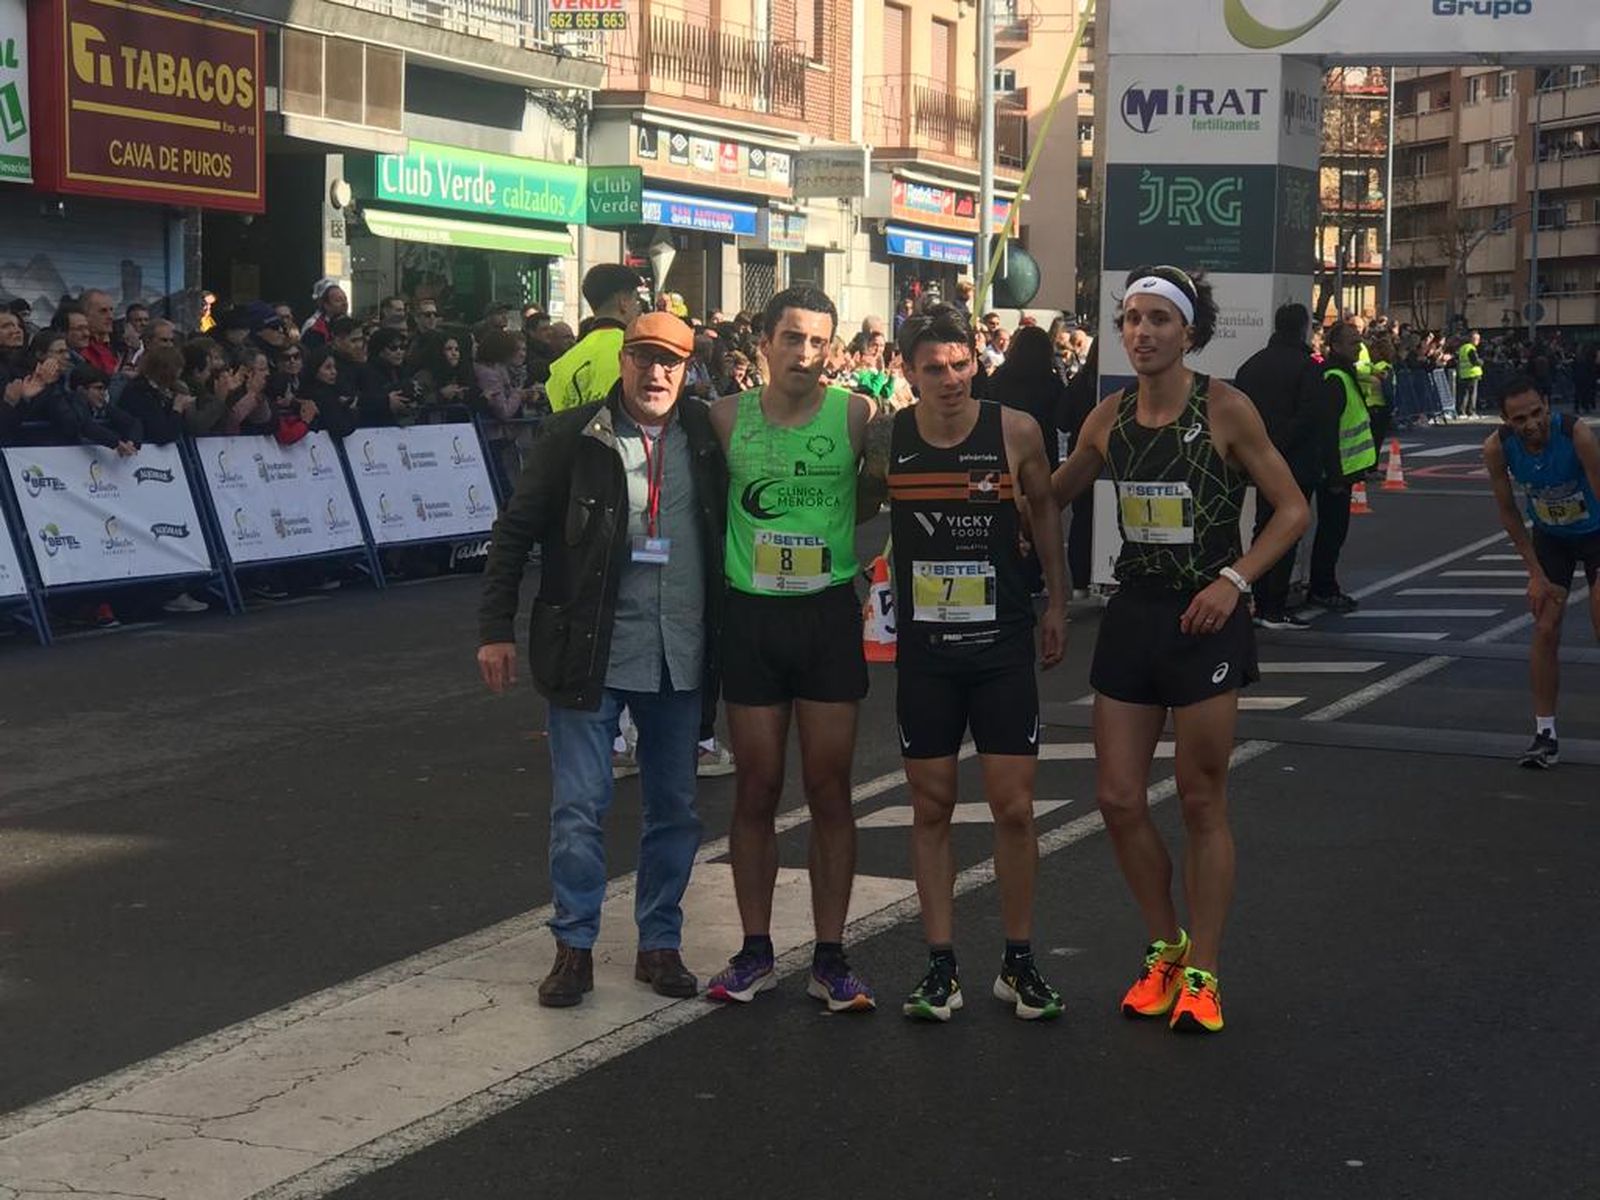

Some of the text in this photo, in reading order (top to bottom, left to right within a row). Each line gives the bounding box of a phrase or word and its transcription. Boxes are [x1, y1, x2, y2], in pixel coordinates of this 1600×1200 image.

[1433, 0, 1532, 19] Grupo
[550, 13, 625, 28] 662 655 663
[0, 38, 18, 68] L
[120, 46, 253, 108] TABACOS
[1191, 118, 1261, 131] fertilizantes
[109, 139, 232, 178] CAVA DE PUROS
[382, 154, 566, 216] Club Verde calzados
[593, 175, 632, 195] Club
[590, 197, 639, 214] Verde
[778, 496, 840, 507] MENORCA
[1145, 498, 1152, 523] 1
[946, 515, 993, 527] VICKY
[951, 529, 989, 537] FOODS
[781, 548, 792, 571] 8
[943, 578, 954, 601] 7
